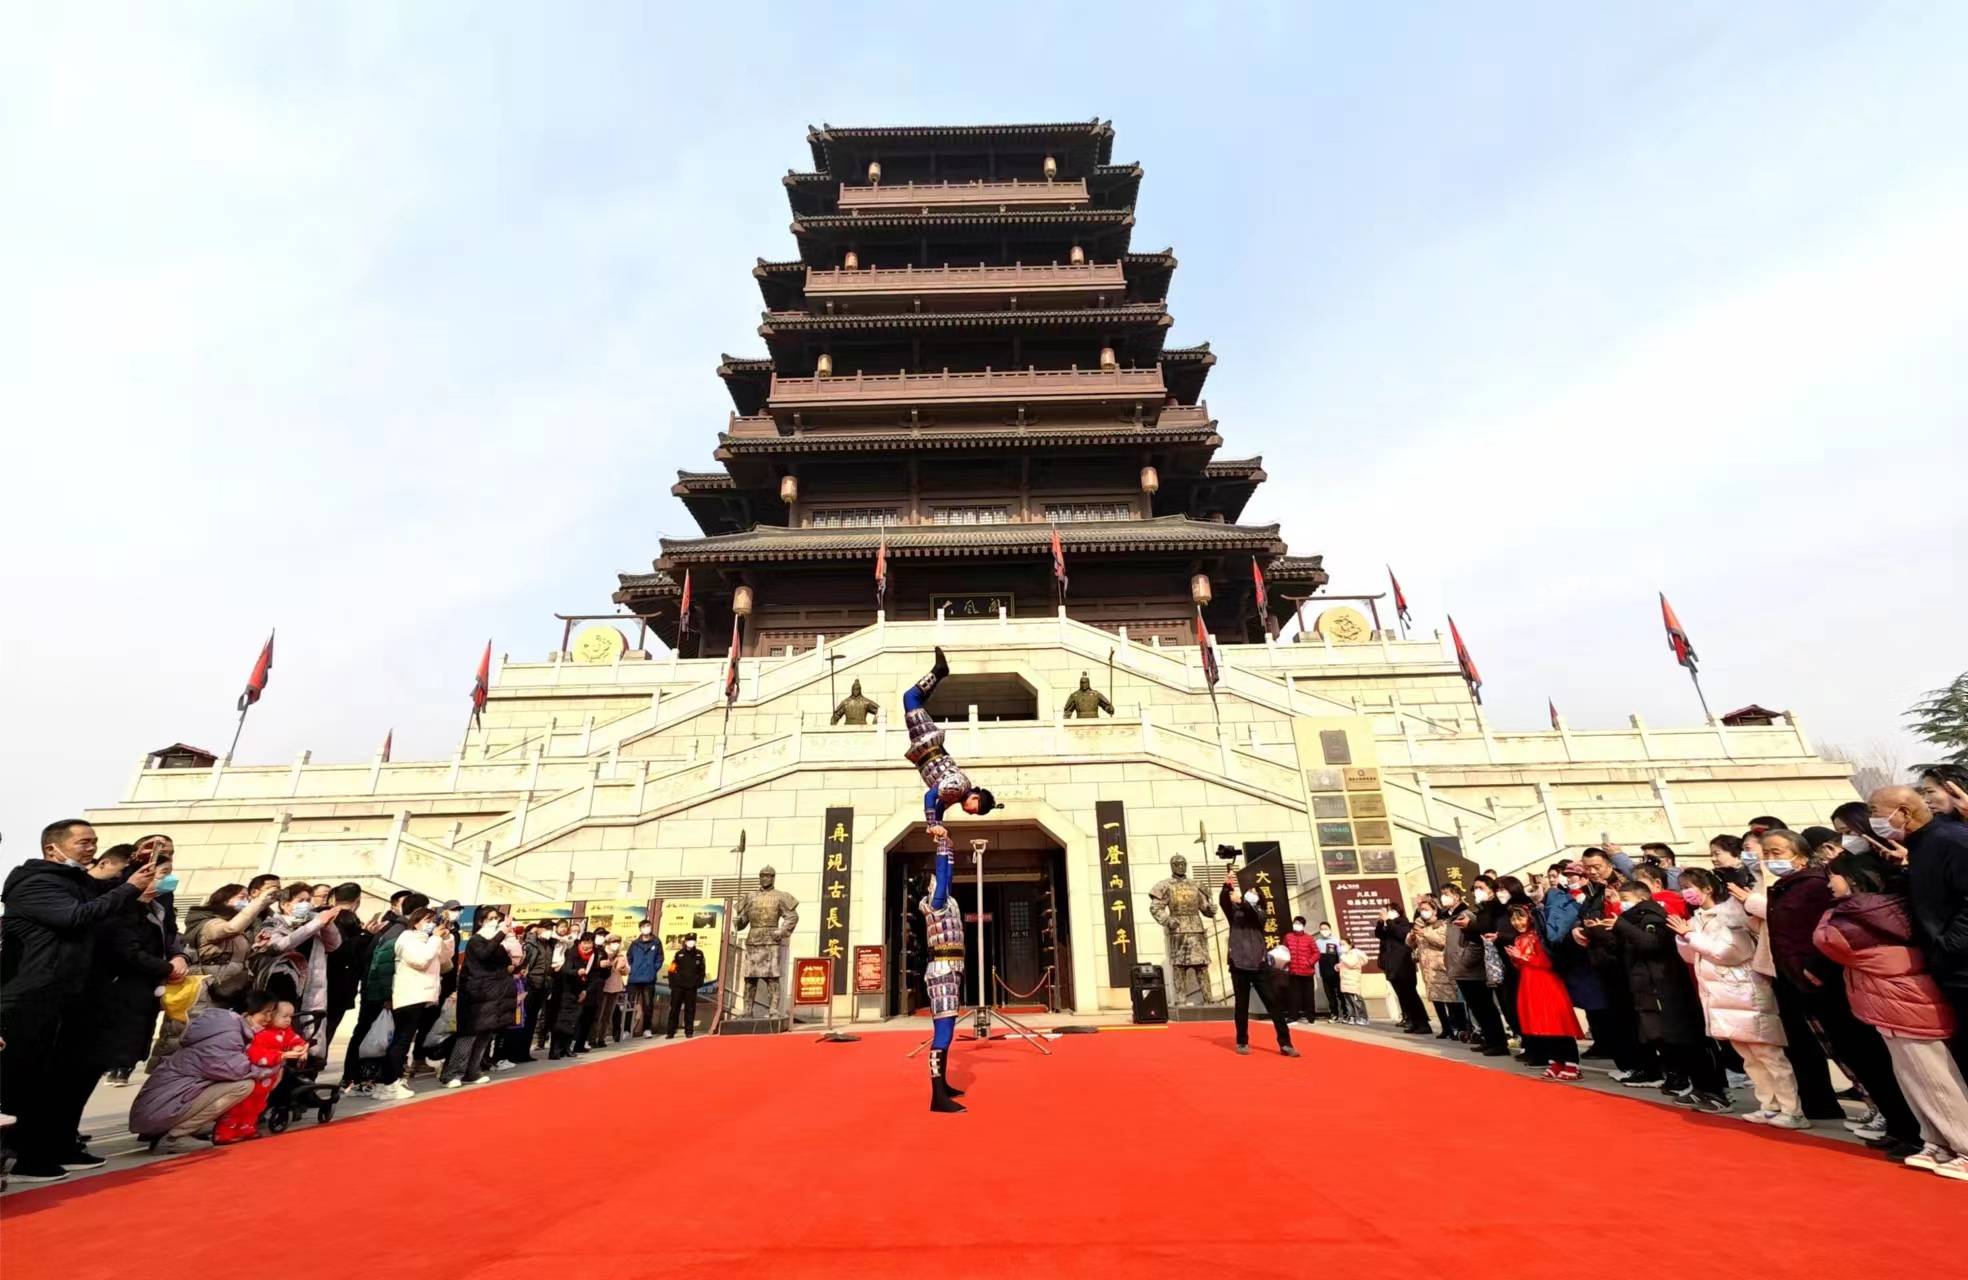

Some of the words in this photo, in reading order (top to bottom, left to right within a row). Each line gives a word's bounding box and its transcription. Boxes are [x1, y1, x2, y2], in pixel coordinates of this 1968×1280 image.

[823, 822, 848, 959] 再現古長安
[1103, 822, 1131, 954] 一登兩千年
